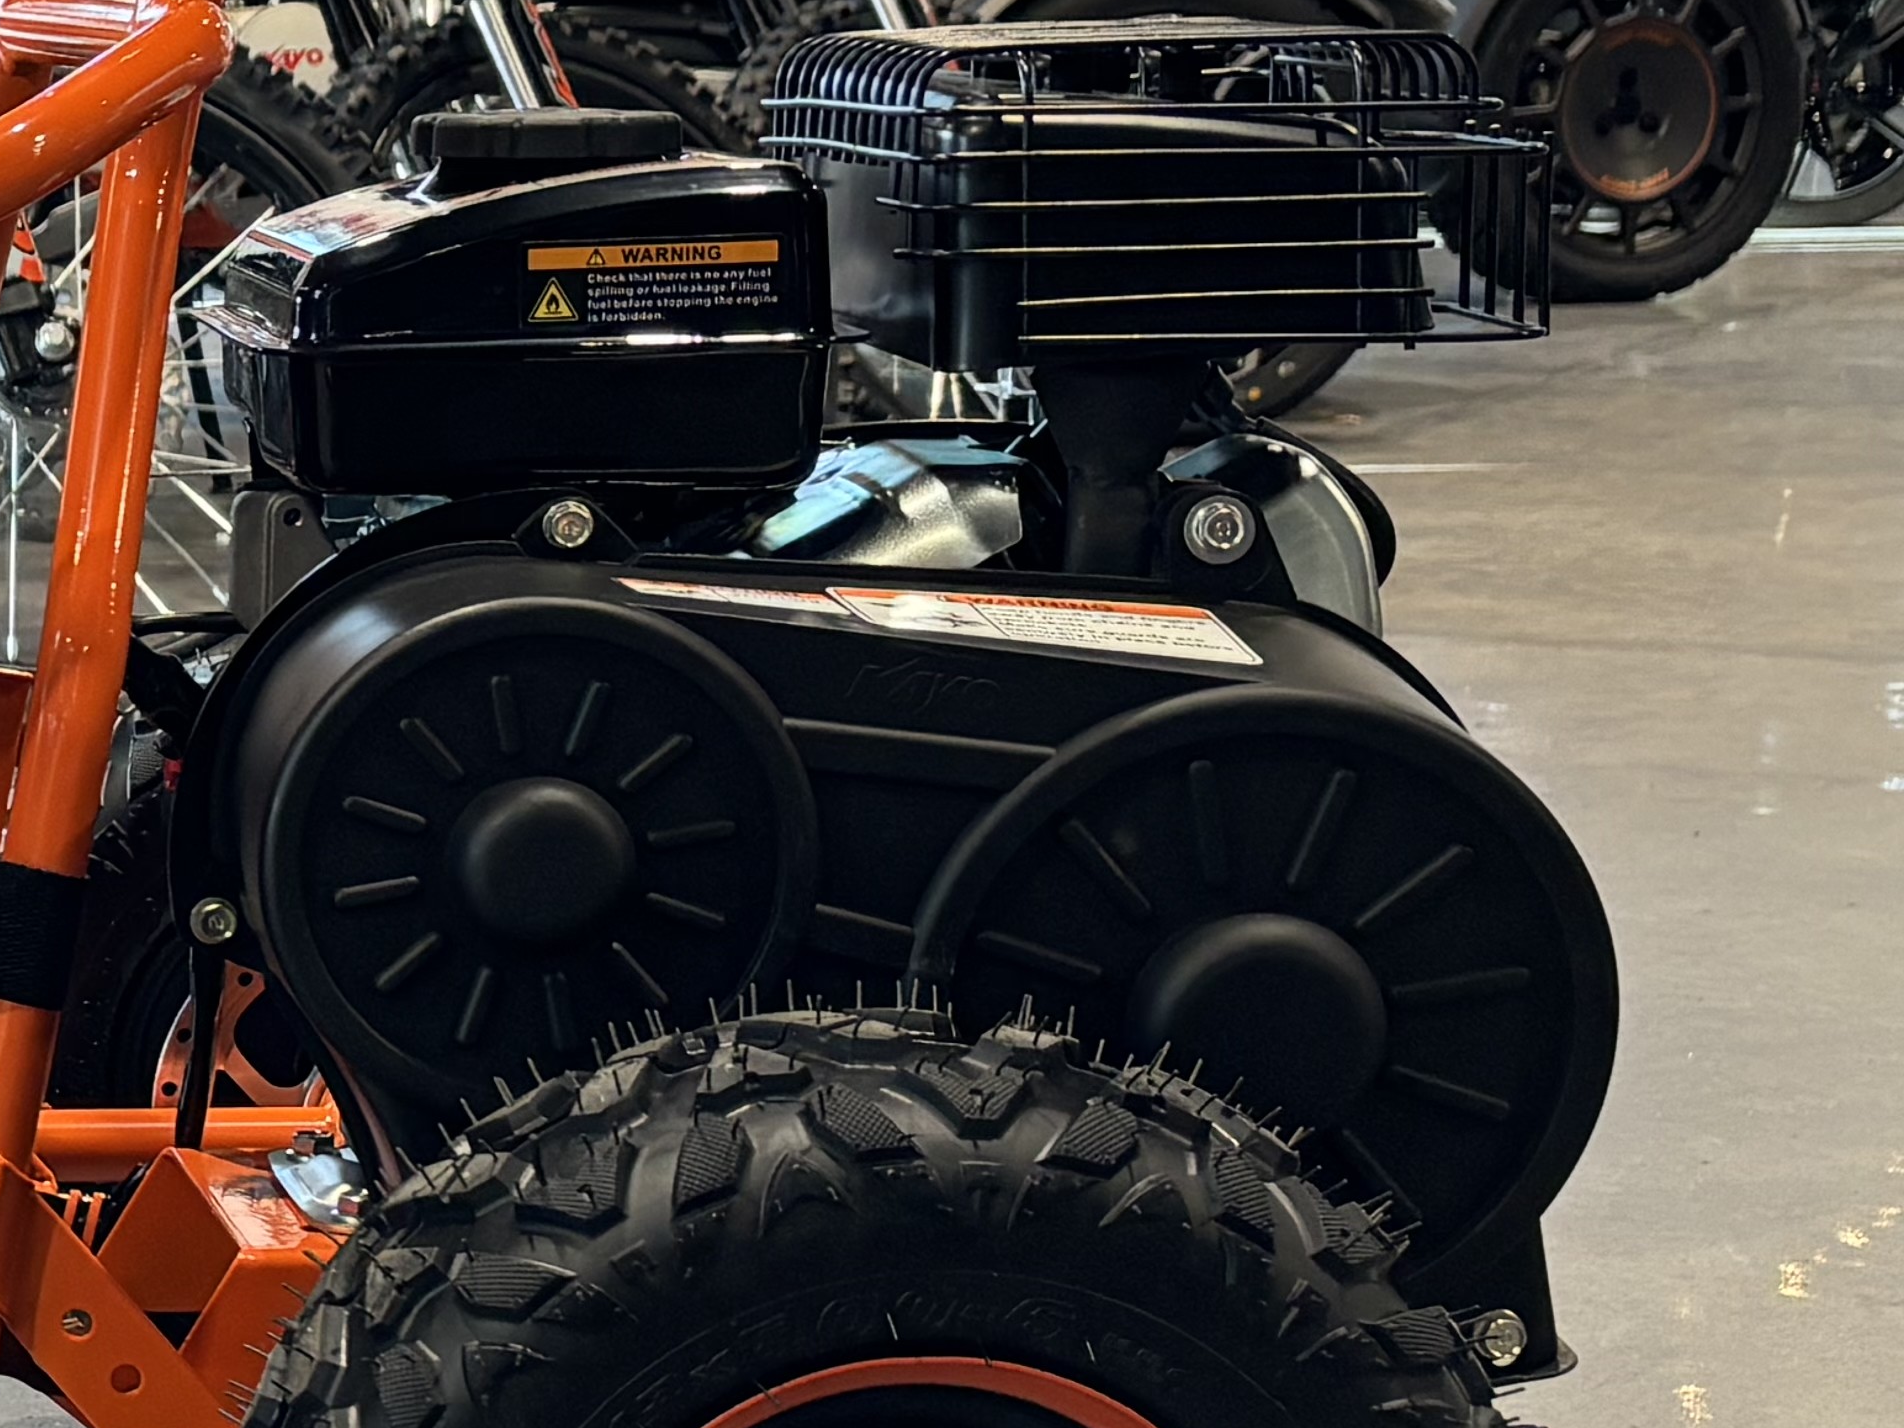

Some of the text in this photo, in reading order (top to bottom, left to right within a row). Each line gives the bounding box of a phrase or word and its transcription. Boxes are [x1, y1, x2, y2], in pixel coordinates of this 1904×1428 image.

[621, 245, 723, 265] WARNING
[587, 273, 626, 284] Check
[628, 271, 653, 282] that
[656, 271, 689, 282] there
[723, 270, 746, 281] any
[747, 267, 772, 279] fuel
[587, 284, 634, 299] spilling
[587, 294, 779, 310] fuel before stopping the engine
[601, 311, 667, 322] forbidden.
